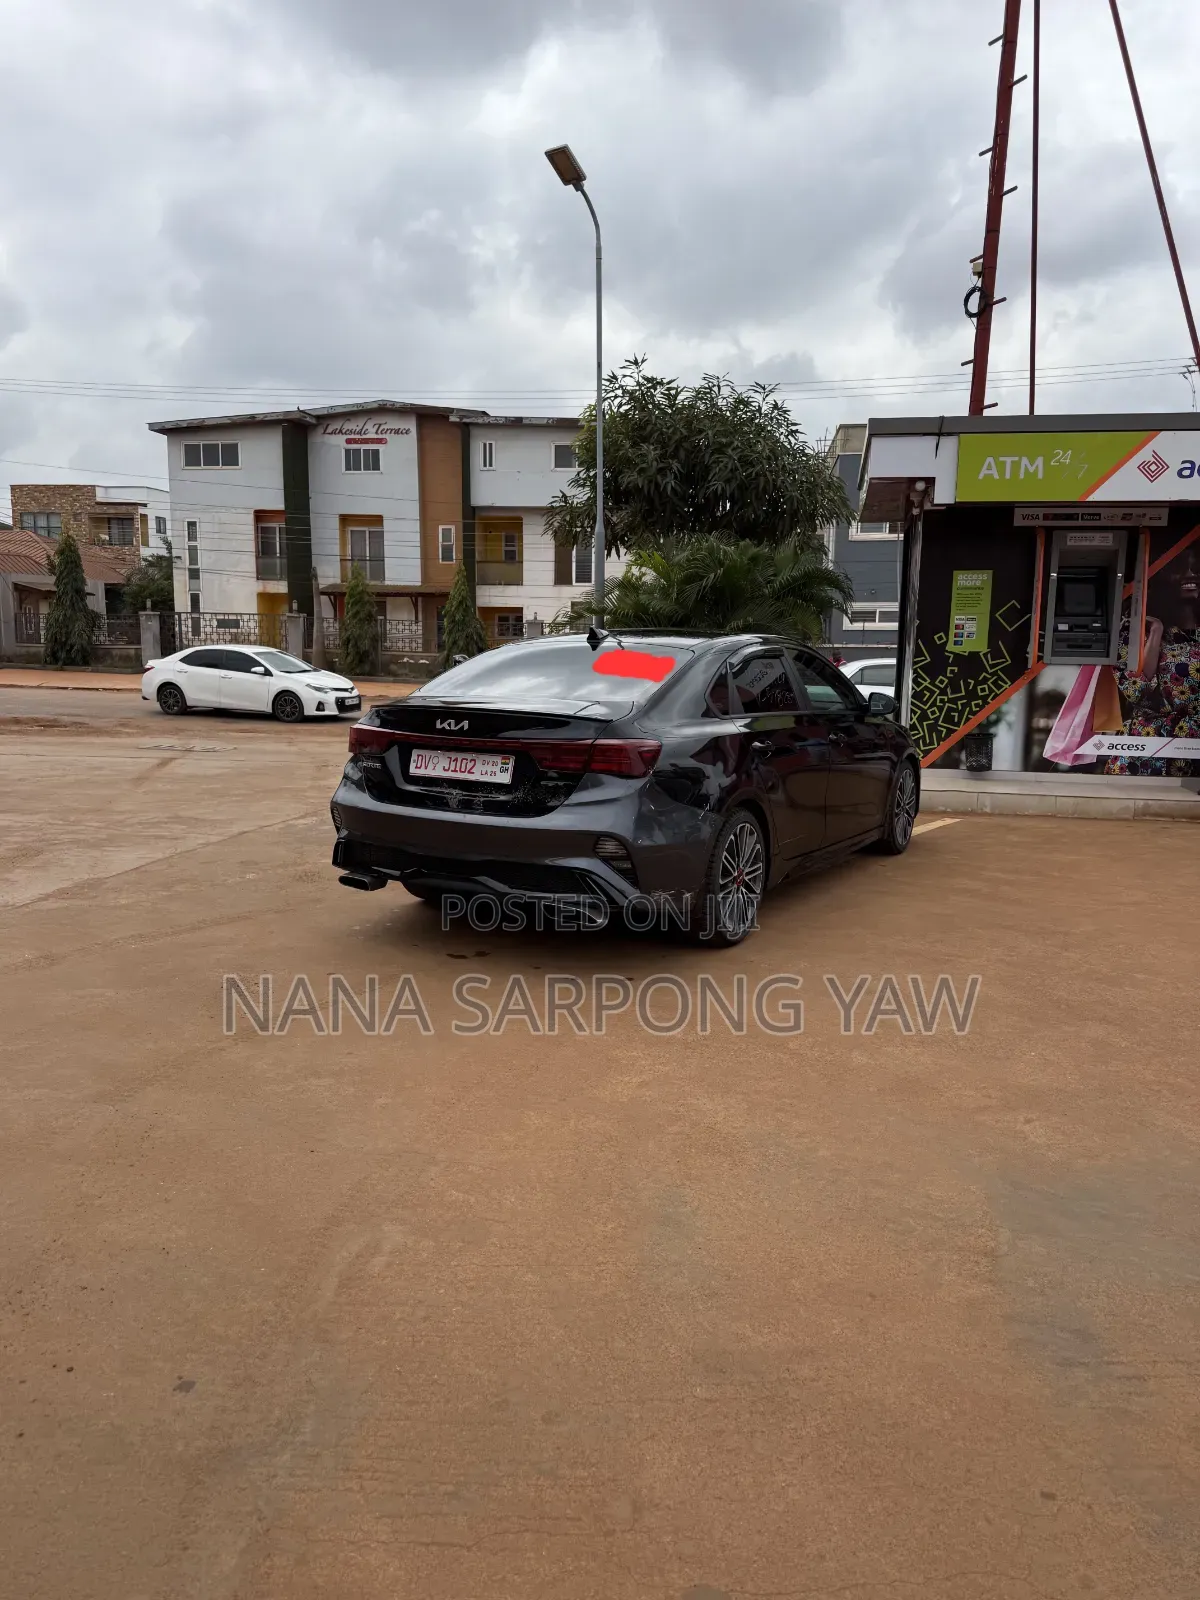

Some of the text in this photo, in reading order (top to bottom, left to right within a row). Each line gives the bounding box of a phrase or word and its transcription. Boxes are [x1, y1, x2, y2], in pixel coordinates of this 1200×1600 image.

[322, 418, 411, 436] Lakeside Terrace
[977, 456, 1044, 480] ATM
[1021, 513, 1040, 521] VISA
[435, 718, 469, 731] KIA
[1107, 742, 1147, 752] access
[414, 753, 477, 775] DV J102
[499, 765, 510, 774] GH
